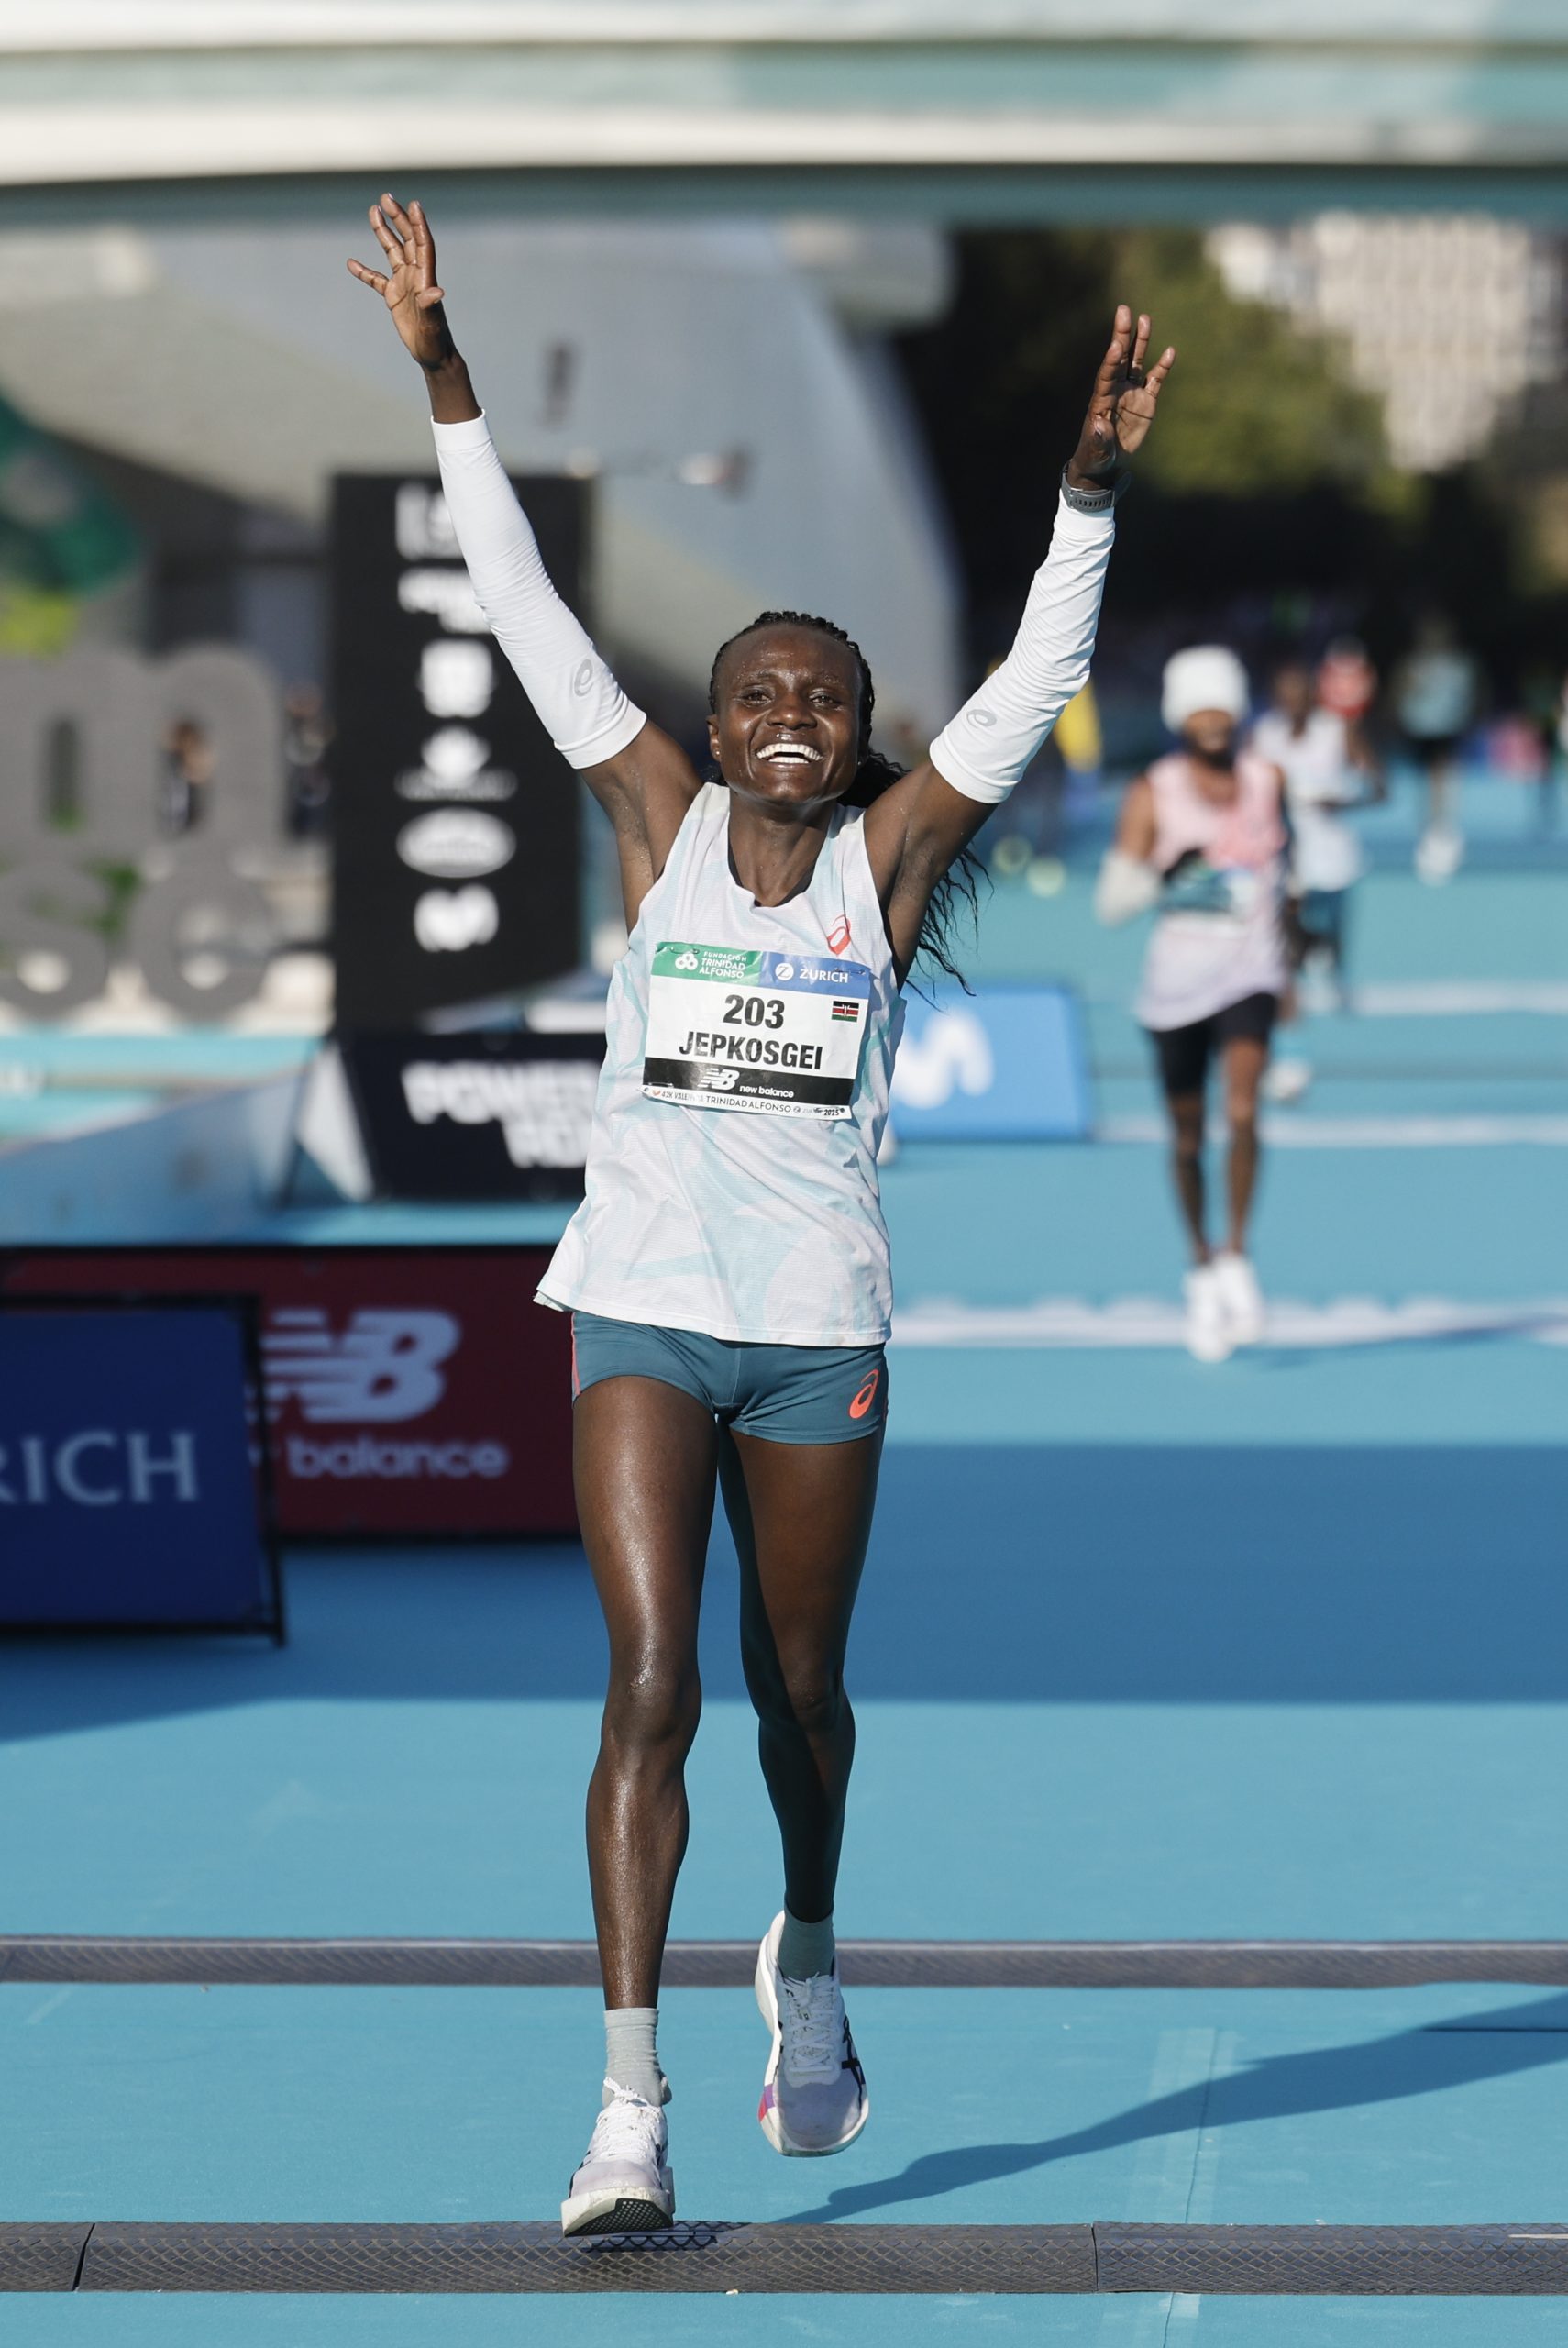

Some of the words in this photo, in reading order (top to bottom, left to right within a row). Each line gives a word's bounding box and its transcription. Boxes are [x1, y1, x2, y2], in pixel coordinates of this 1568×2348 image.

[701, 958, 746, 969] TRINIDAD
[699, 967, 745, 979] ALFONSO
[799, 969, 849, 983] ZURICH
[722, 994, 785, 1029] 203
[679, 1031, 823, 1070] JEPKOSGEI
[739, 1085, 757, 1094] new
[758, 1086, 795, 1098] balance
[706, 1095, 748, 1108] TRINIDAD
[748, 1100, 791, 1113] ALFONSO
[823, 1108, 840, 1116] 2025
[285, 1434, 511, 1479] balance
